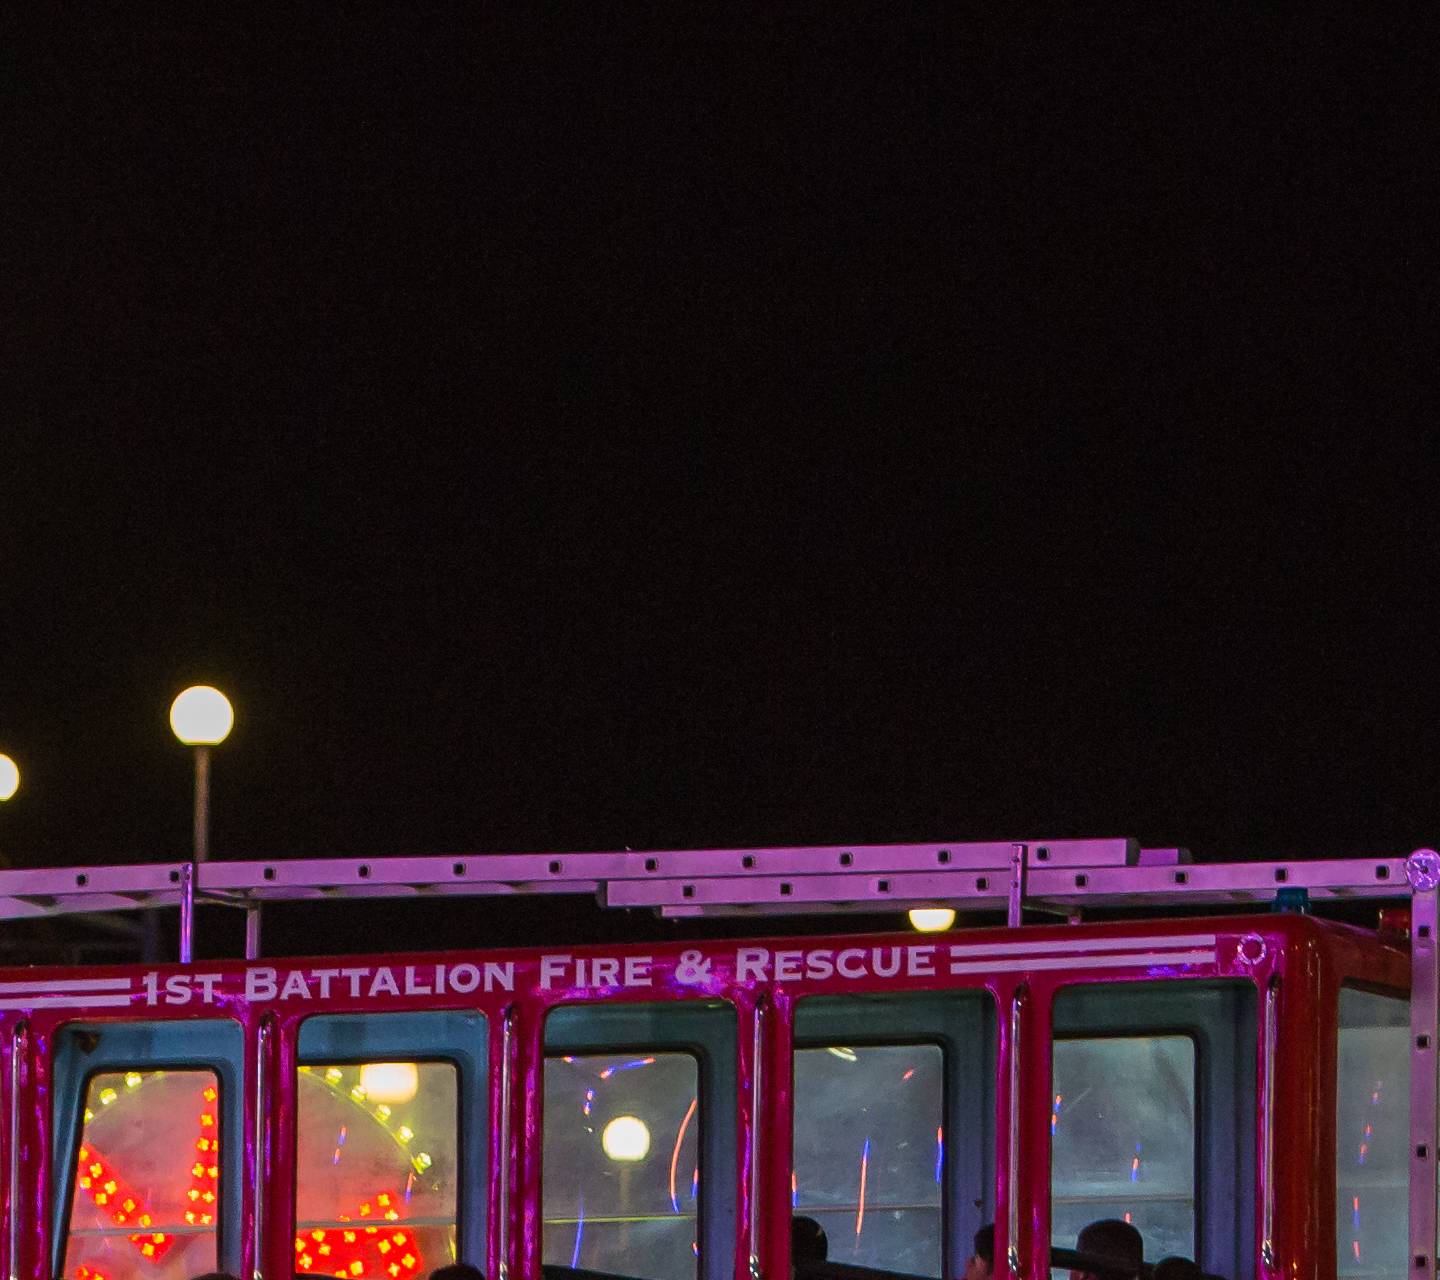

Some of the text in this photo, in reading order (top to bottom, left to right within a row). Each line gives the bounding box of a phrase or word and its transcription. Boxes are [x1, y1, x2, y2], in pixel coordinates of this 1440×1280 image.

[142, 945, 937, 1007] 1ST BATTALION FIRE & RESCUE
